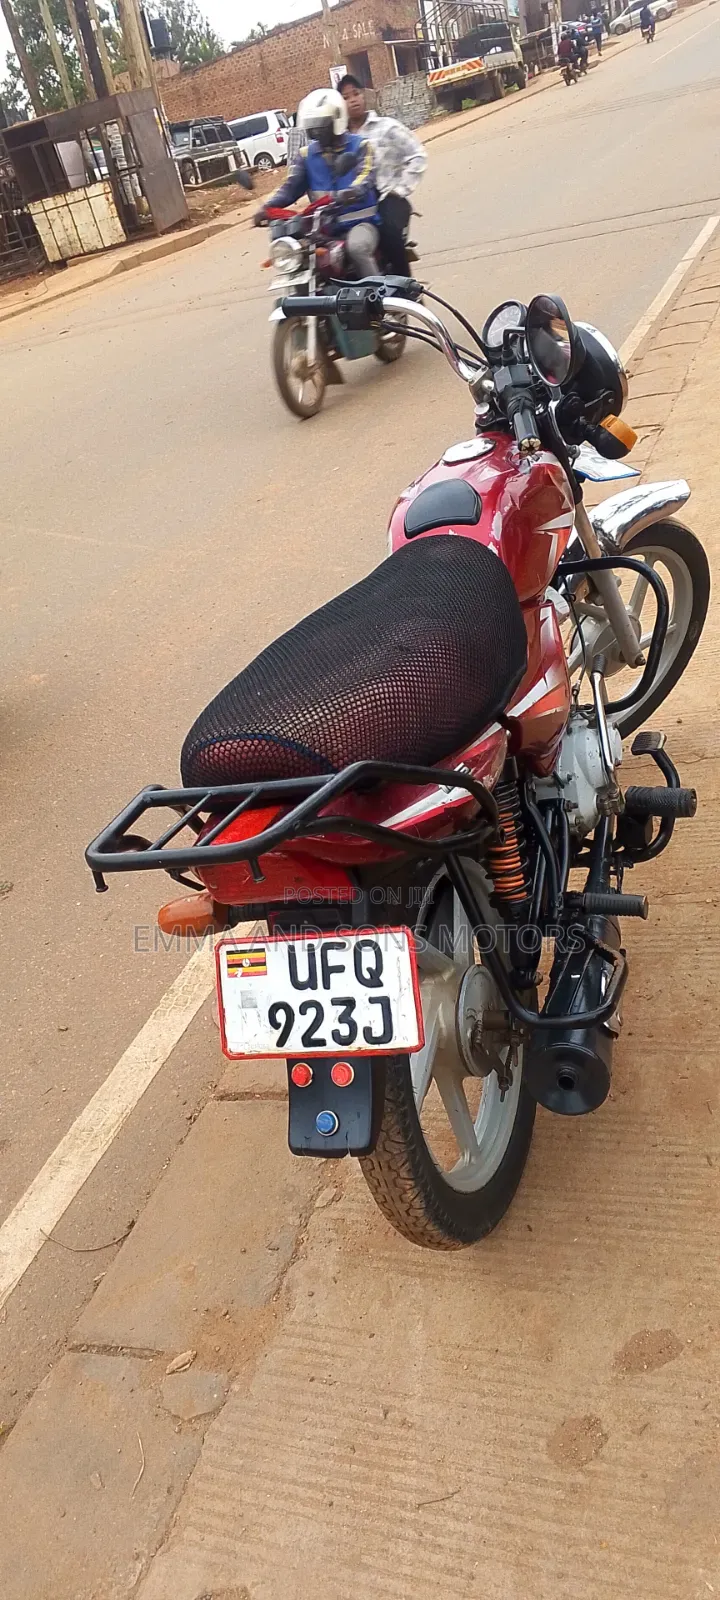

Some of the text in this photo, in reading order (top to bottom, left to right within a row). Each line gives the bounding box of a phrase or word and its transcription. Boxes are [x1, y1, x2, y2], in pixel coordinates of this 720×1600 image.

[352, 20, 376, 39] SALE
[287, 939, 384, 991] UFQ
[268, 995, 394, 1048] 923J
